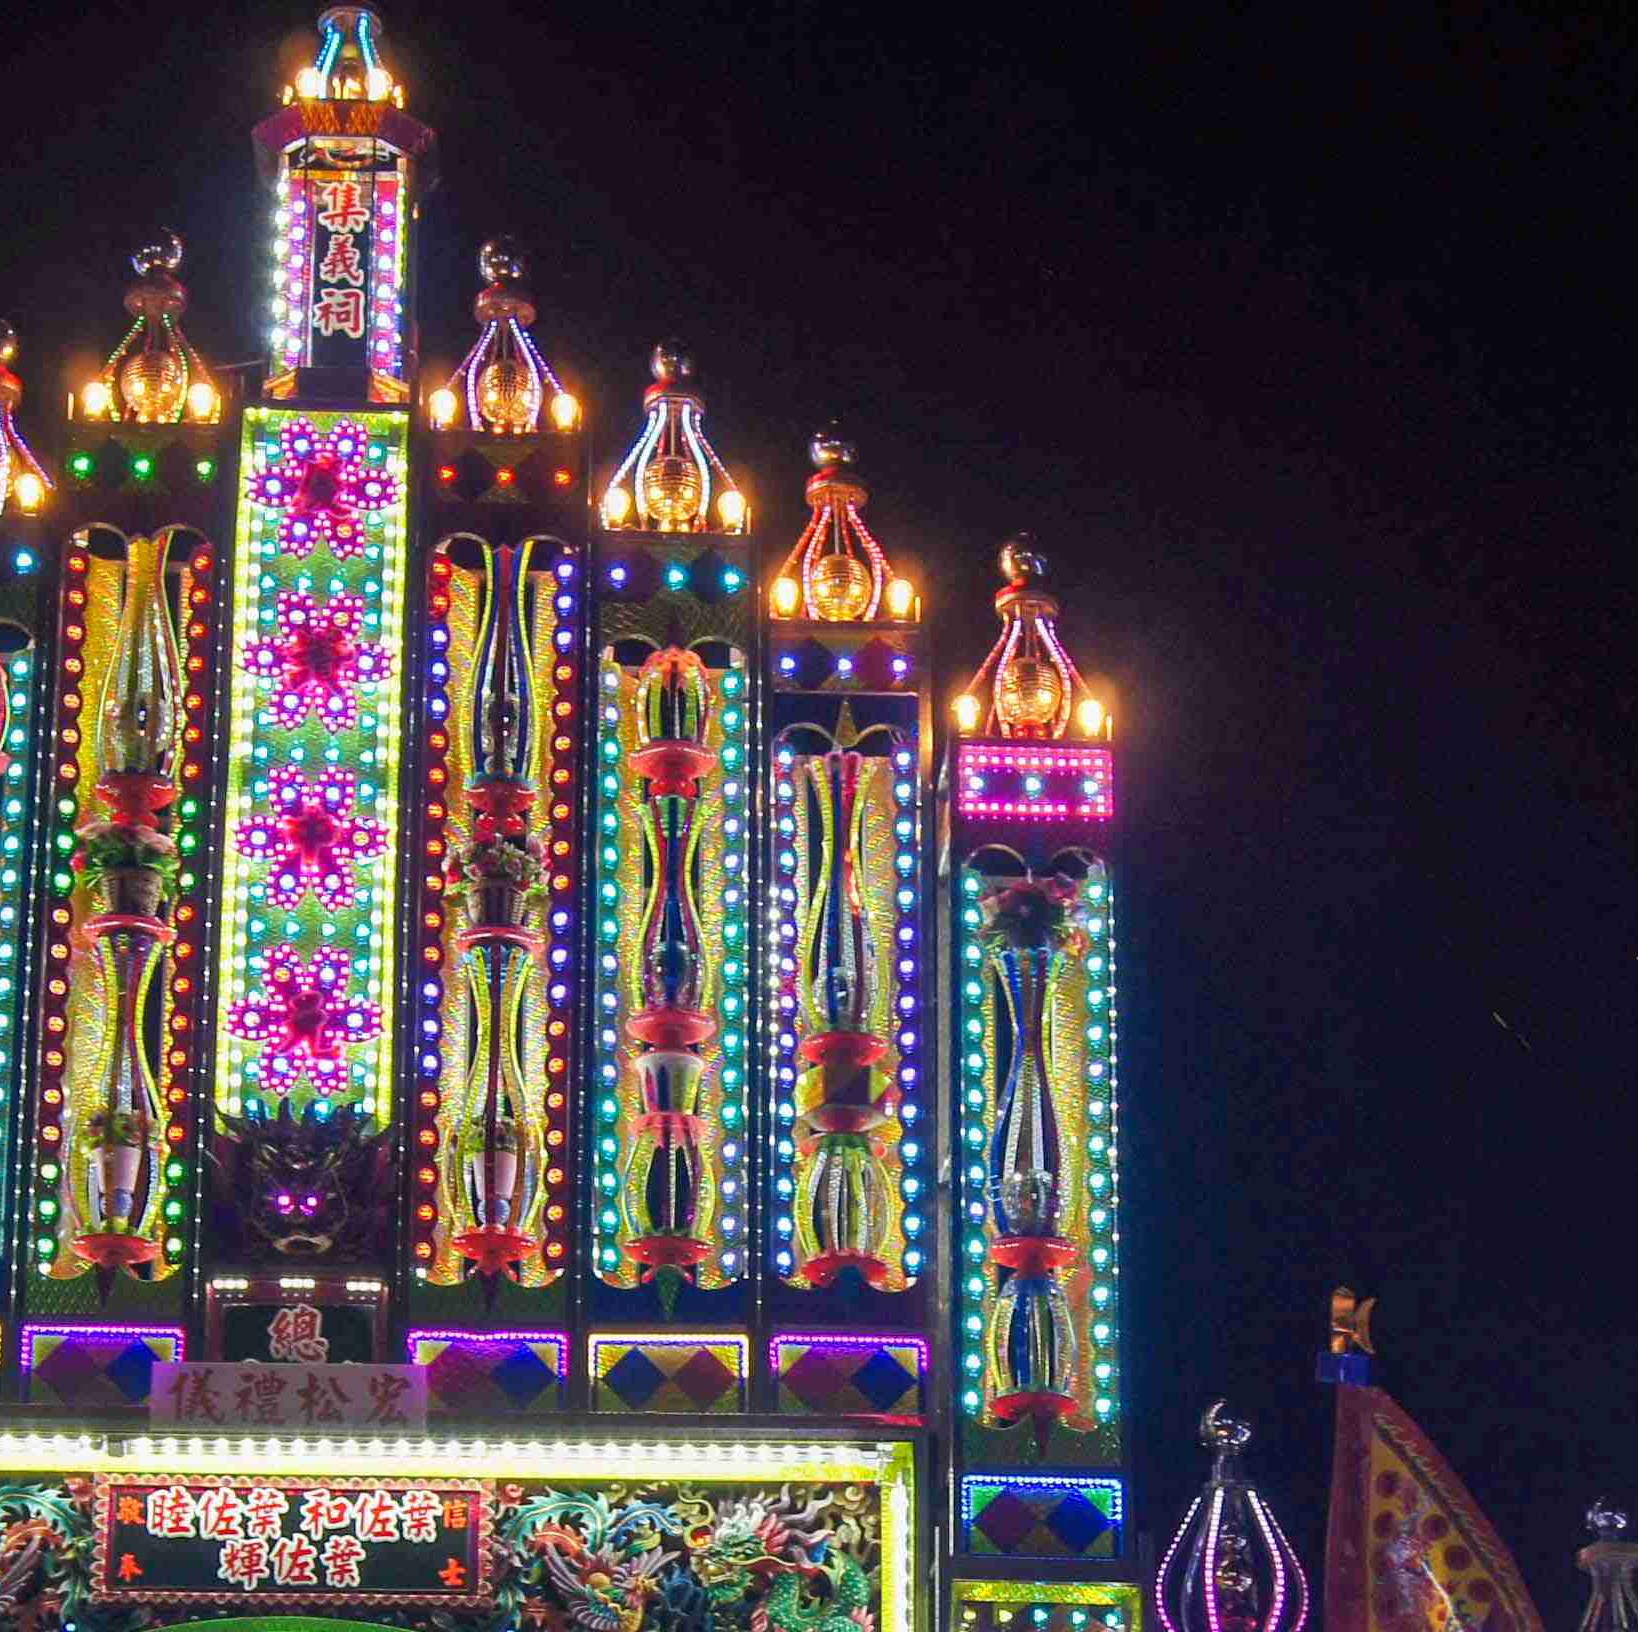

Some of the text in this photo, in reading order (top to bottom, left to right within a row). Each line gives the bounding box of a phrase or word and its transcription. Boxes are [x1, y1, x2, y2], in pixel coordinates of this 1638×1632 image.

[314, 181, 370, 338] 集義祠
[267, 1303, 330, 1363] 總
[167, 1369, 412, 1427] 宏松禮儀
[116, 1495, 145, 1582] 敬奉
[147, 1485, 443, 1543] 葉佐和 葉佐睦
[438, 1499, 468, 1586] 信士
[217, 1533, 366, 1590] 葉佐輝
